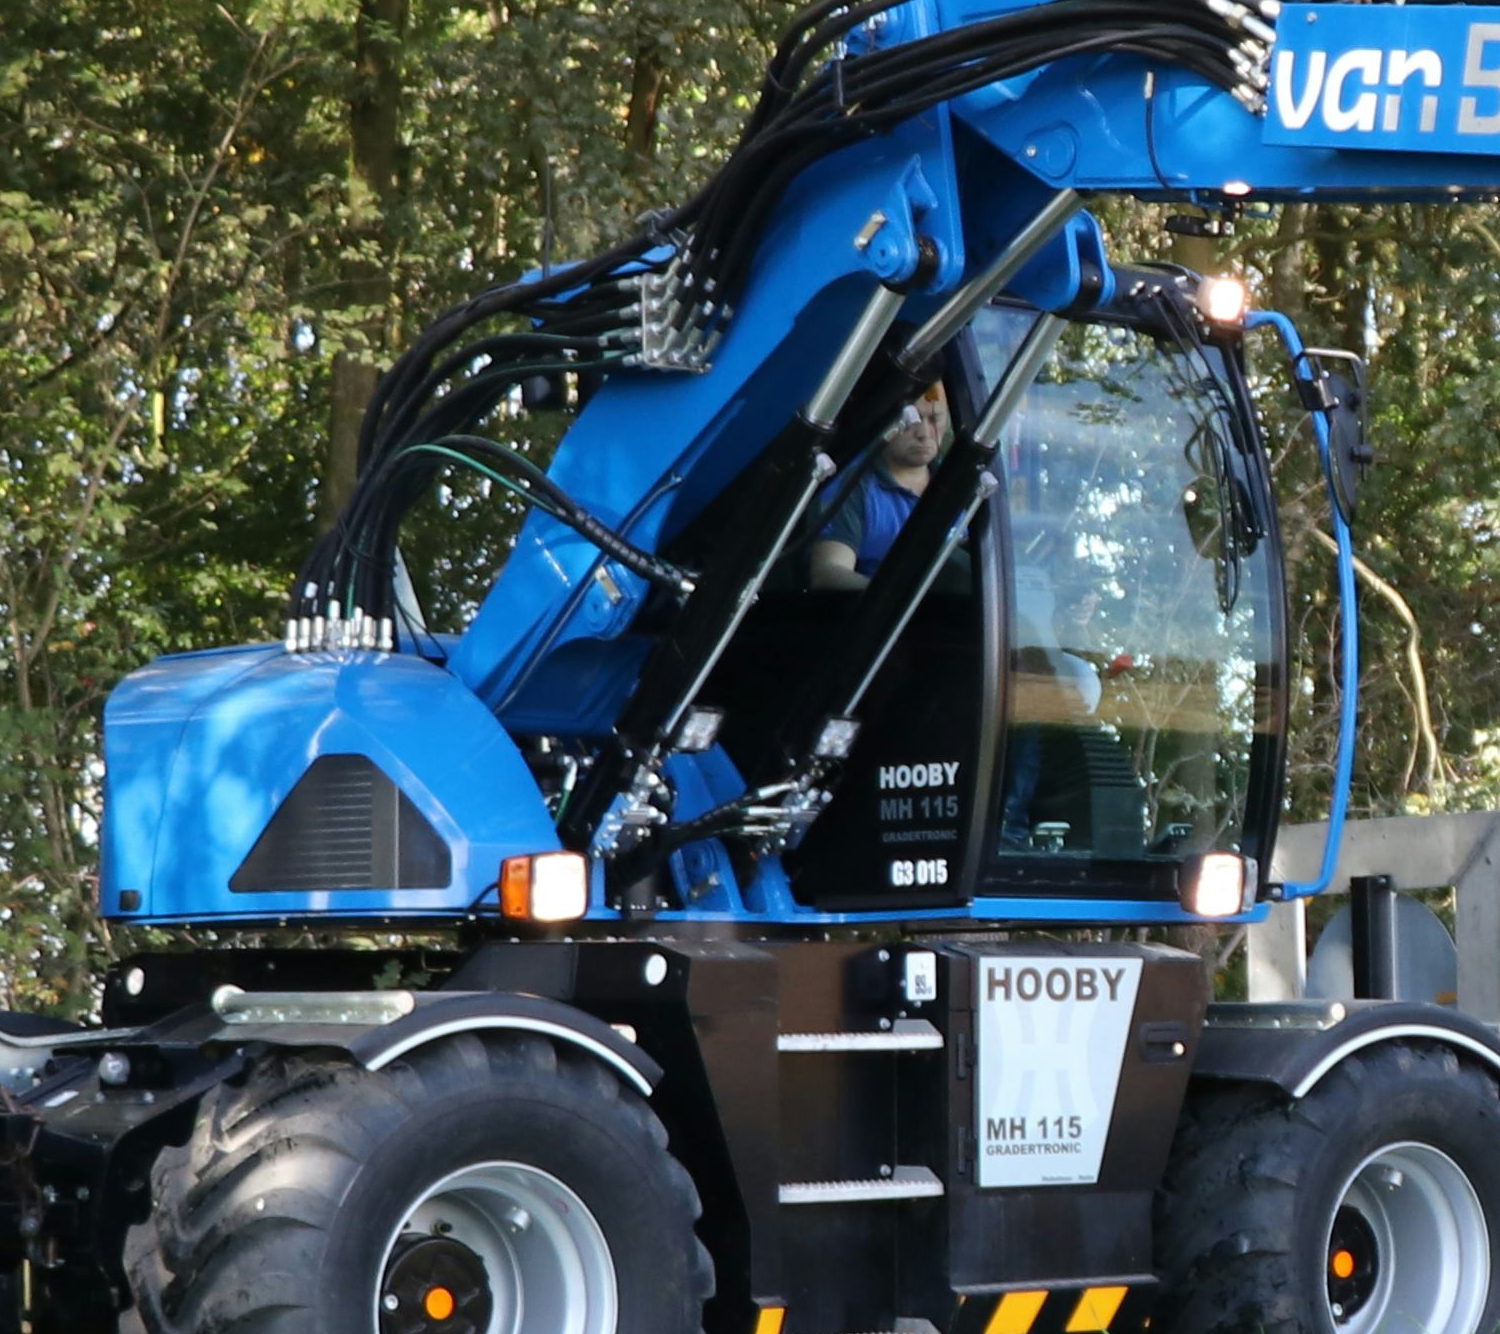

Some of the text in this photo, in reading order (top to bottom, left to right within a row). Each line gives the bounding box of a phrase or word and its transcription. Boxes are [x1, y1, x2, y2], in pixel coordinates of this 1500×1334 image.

[1276, 48, 1443, 132] van
[879, 762, 960, 789] HOOBY
[880, 795, 959, 820] MH 115
[882, 829, 958, 843] GRADERTRONIC
[891, 858, 948, 886] G3 015
[987, 966, 1126, 1002] HOOBY
[986, 1115, 1082, 1141] MH 115
[986, 1142, 1082, 1156] GRADERTRONIC
